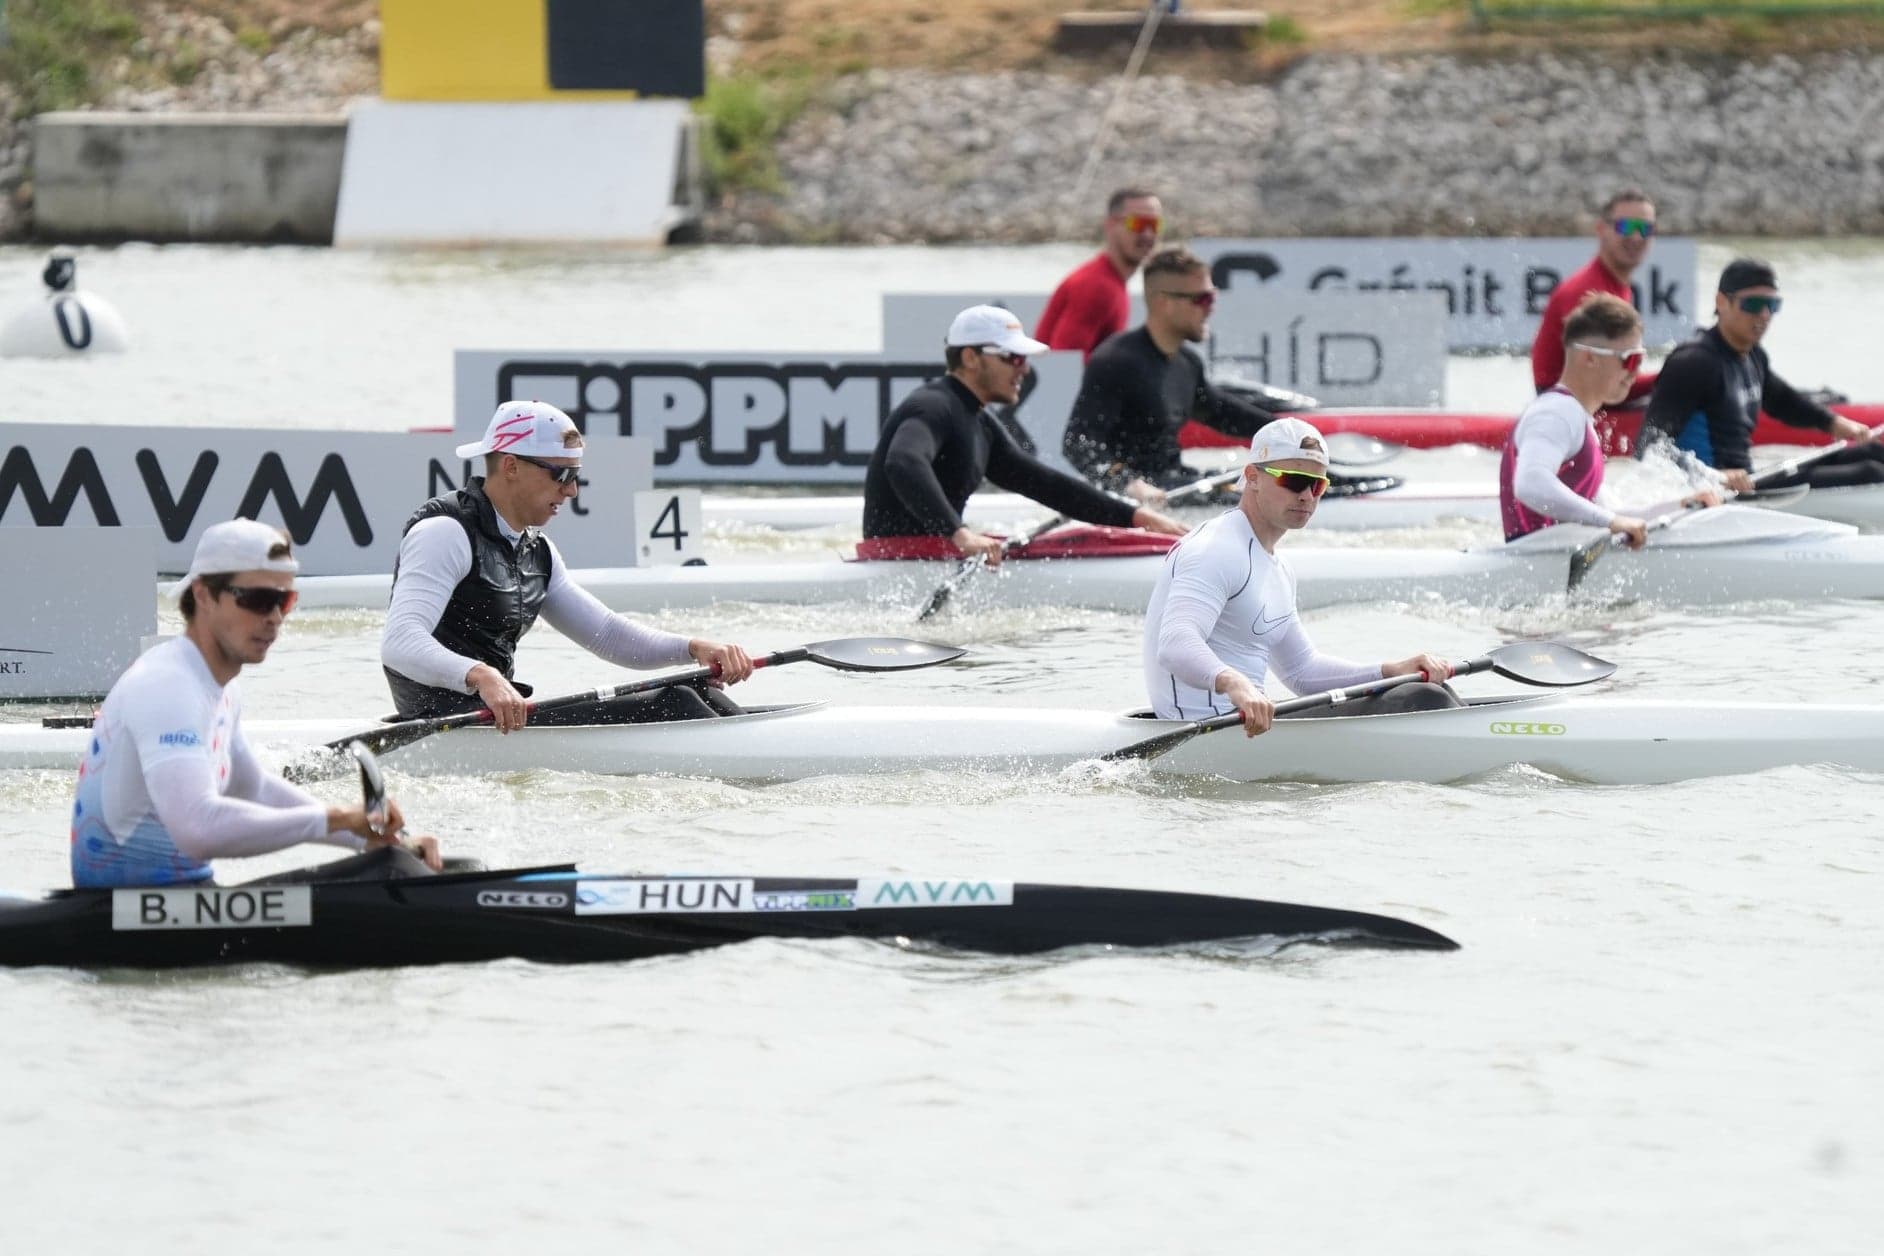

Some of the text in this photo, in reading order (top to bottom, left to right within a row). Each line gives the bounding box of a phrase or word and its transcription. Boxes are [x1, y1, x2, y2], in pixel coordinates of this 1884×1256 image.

[0, 444, 374, 548] MVM
[650, 495, 689, 551] 4
[1491, 722, 1566, 735] NELO
[480, 892, 565, 907] NELO
[638, 883, 742, 909] HUN
[874, 881, 997, 904] MVM
[140, 890, 285, 924] B. NOE
